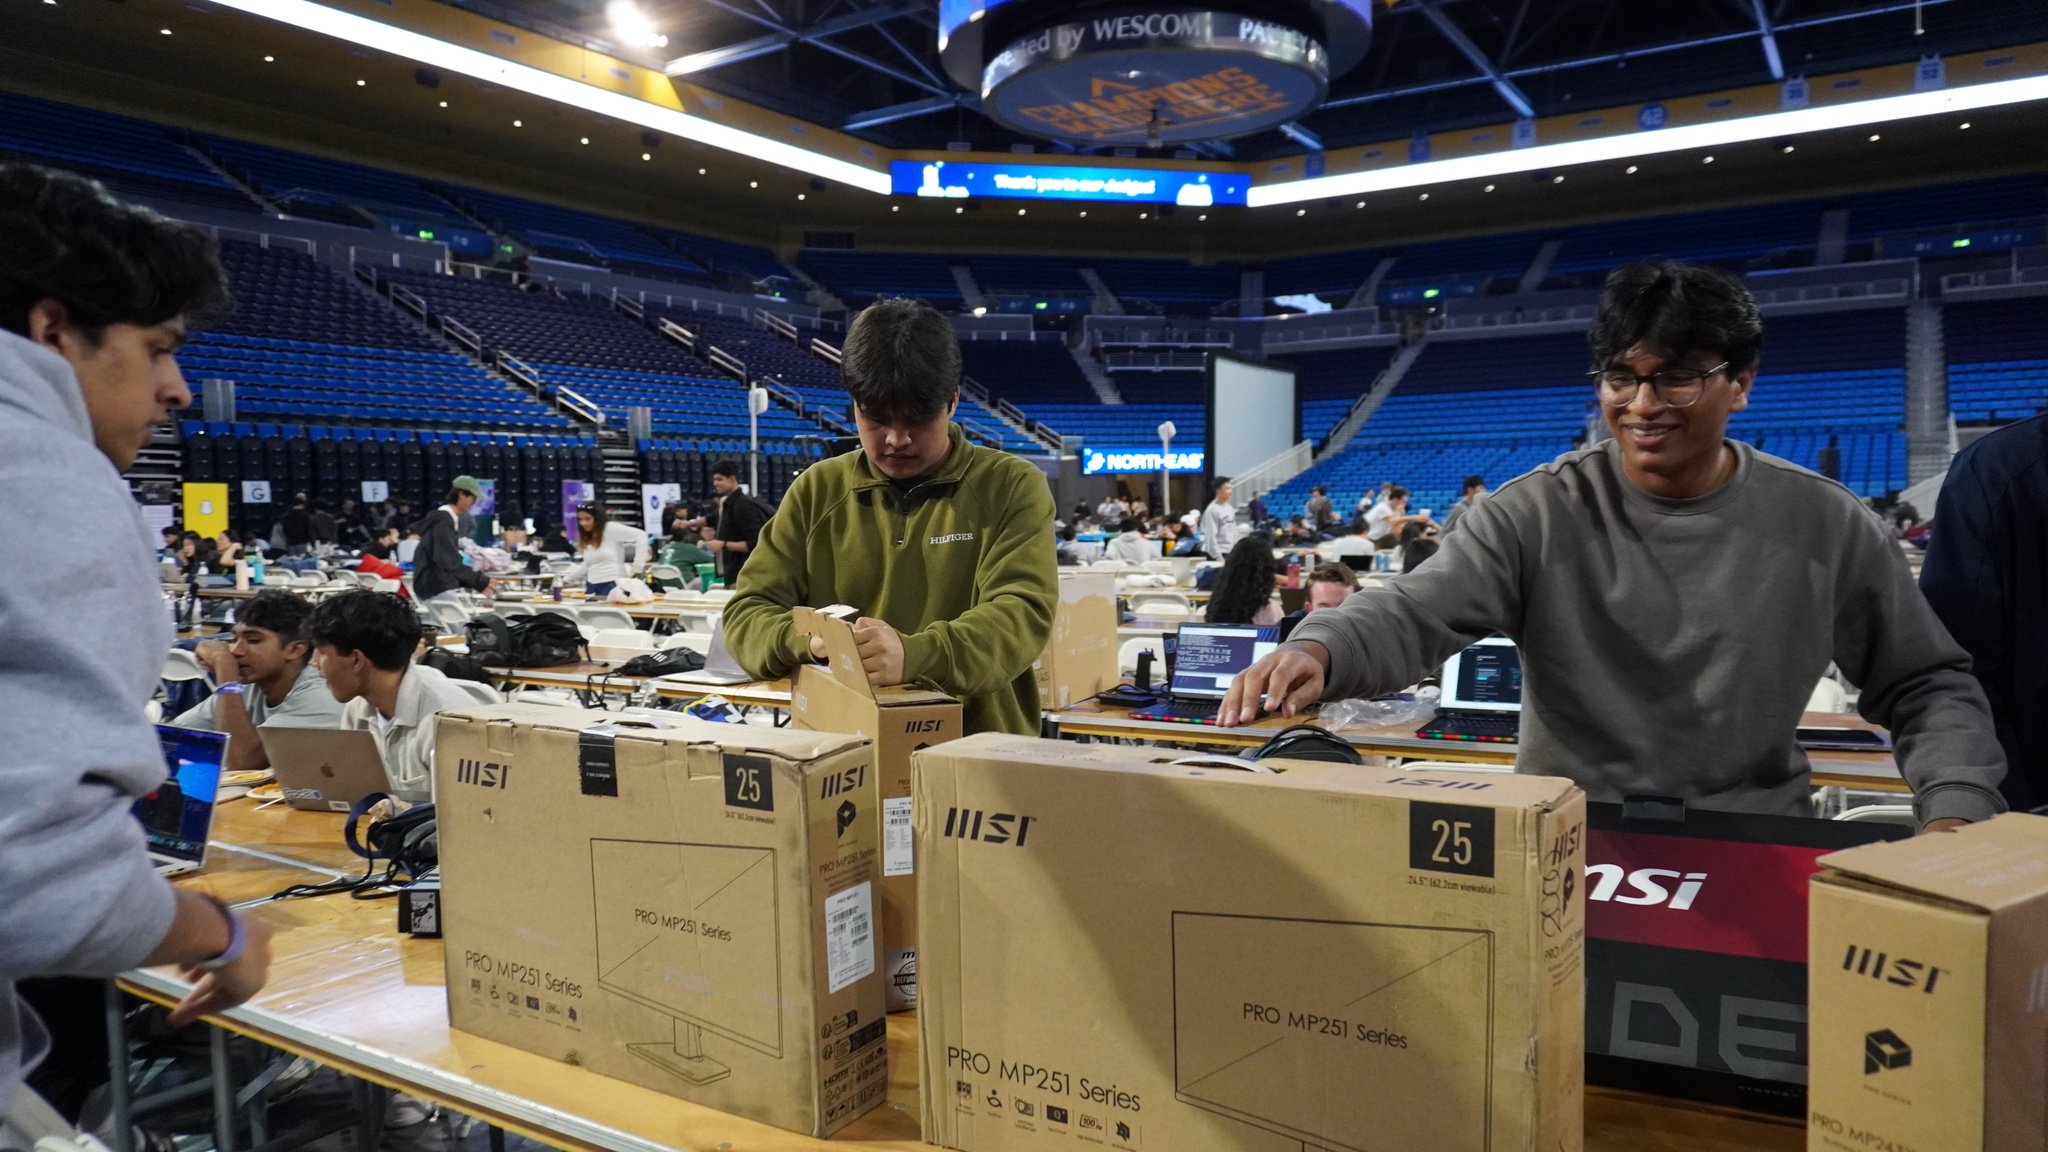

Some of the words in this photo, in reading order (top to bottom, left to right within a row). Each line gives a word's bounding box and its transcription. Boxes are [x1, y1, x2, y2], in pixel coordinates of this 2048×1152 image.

[1057, 25, 1086, 51] by
[1093, 14, 1202, 41] WESCOM
[1018, 66, 1260, 121] CHAMPIONS
[995, 174, 1036, 189] Thank
[1037, 179, 1063, 193] you
[1063, 178, 1079, 191] to
[1079, 180, 1104, 192] our
[251, 487, 265, 501] G
[371, 488, 380, 499] F
[930, 533, 974, 544] HILFIGER
[905, 720, 944, 734] MSI
[457, 758, 508, 789] MSI
[736, 767, 761, 802] 25
[821, 765, 868, 800] MSI
[944, 807, 1030, 847] MSI
[1431, 819, 1473, 865] 25
[819, 862, 834, 875] PRO
[1429, 878, 1459, 890] (62.2cm
[1459, 882, 1496, 896] viewable)
[634, 908, 658, 926] PRO
[661, 914, 697, 935] MP251
[701, 922, 733, 942] Series
[465, 950, 492, 973] PRO
[497, 961, 541, 988] MP251
[545, 972, 583, 1000] Series
[1843, 944, 1940, 994] MSI
[1243, 1002, 1281, 1024] PRO
[1288, 1011, 1348, 1038] MP251
[1356, 1023, 1408, 1049] Series
[1606, 981, 1808, 1085] DE
[947, 1046, 991, 1075] PRO
[999, 1058, 1070, 1096] MP251
[1079, 1077, 1141, 1112] Series
[1082, 1117, 1095, 1127] 100
[1812, 1111, 1843, 1135] PRO
